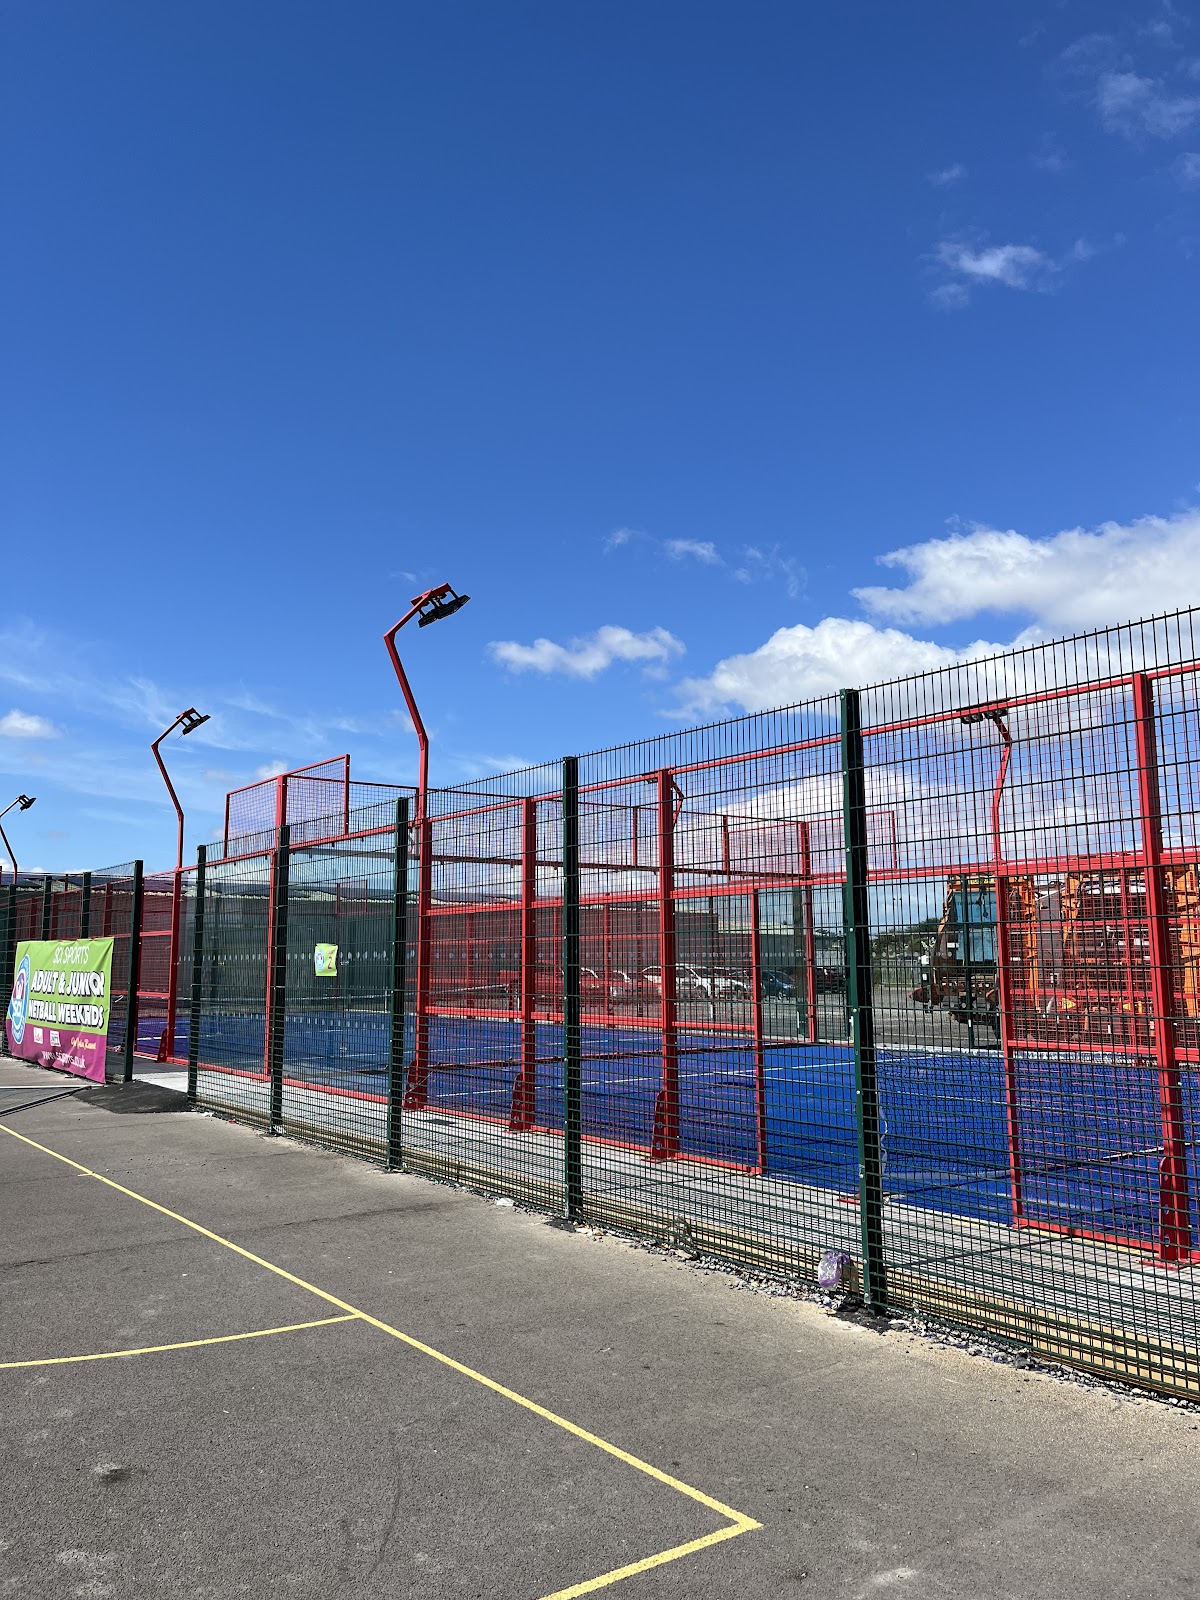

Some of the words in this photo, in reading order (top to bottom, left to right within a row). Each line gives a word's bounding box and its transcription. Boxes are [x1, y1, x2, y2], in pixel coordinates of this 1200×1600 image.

[53, 946, 64, 964] SCI
[64, 945, 89, 964] SPORTS
[31, 970, 58, 993] ADULT
[58, 971, 66, 995] &
[28, 999, 57, 1023] NETBALL
